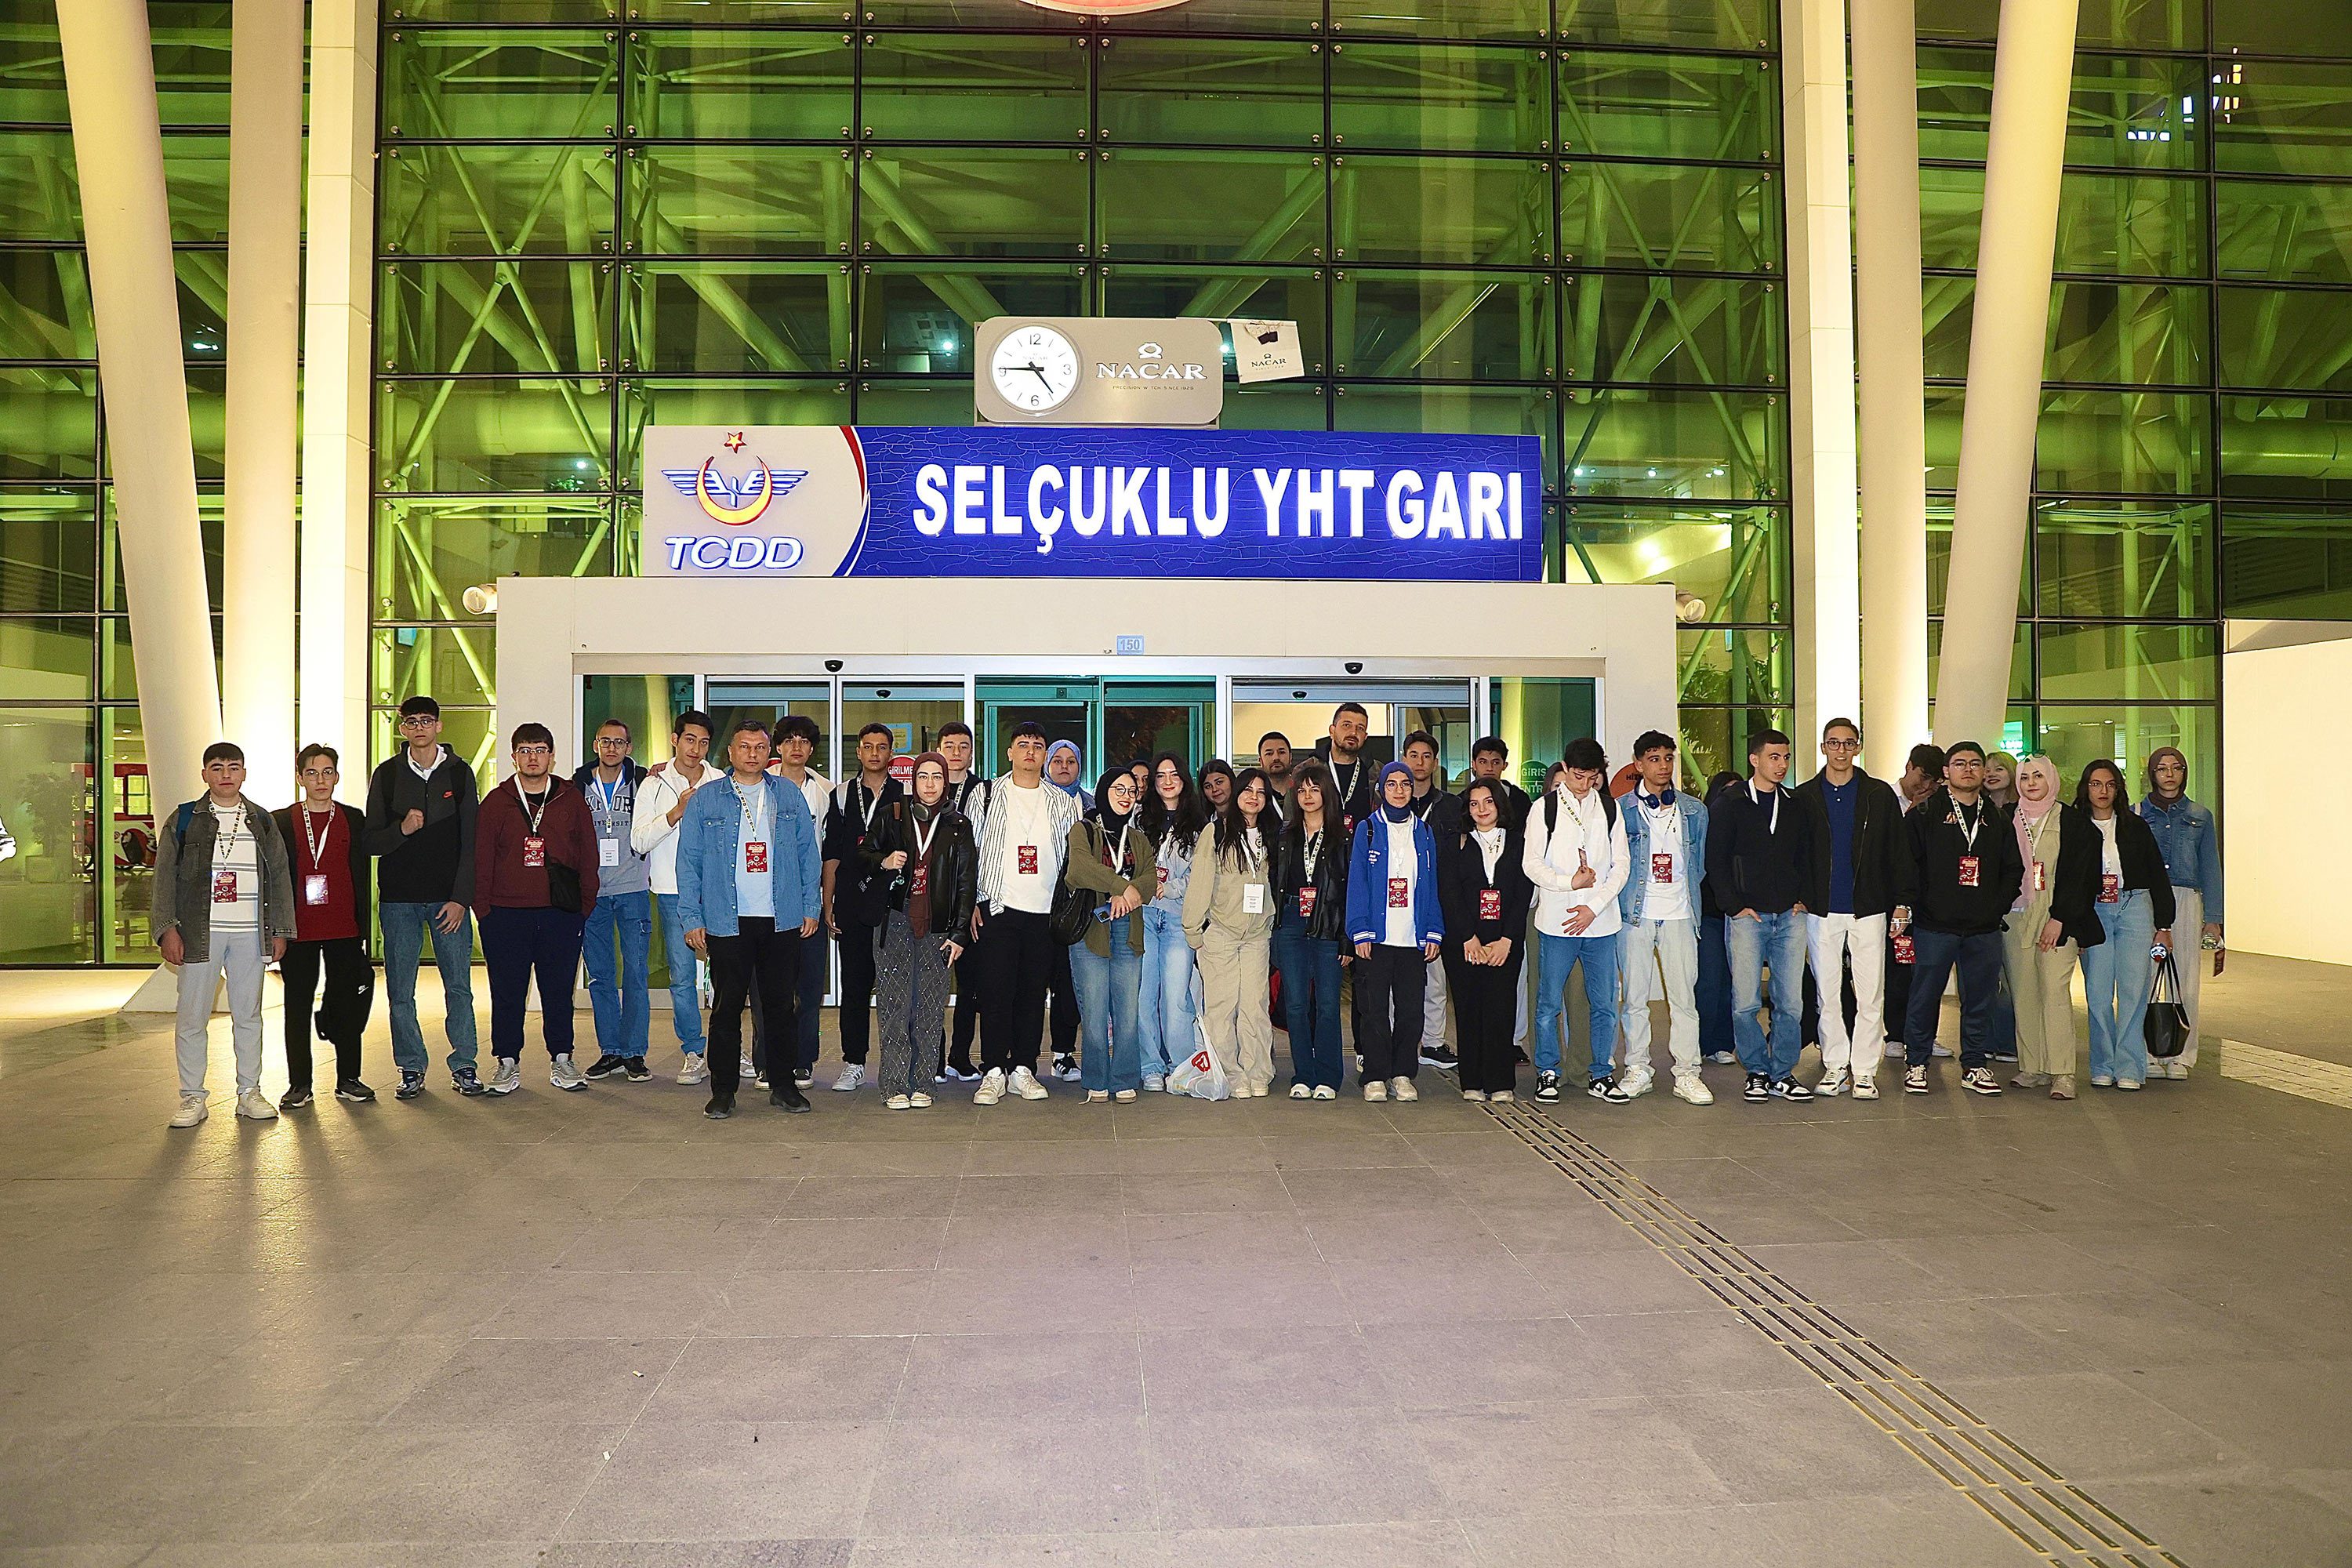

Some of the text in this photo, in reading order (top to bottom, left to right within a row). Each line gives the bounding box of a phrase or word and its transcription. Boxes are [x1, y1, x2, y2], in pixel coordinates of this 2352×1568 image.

[1029, 333, 1041, 345] 12
[1251, 358, 1286, 367] NACAR
[1063, 364, 1072, 375] 3
[1096, 362, 1208, 379] NACAR
[1031, 395, 1040, 406] 6
[912, 463, 1523, 554] SELÇUKLU YHT GARI
[665, 535, 804, 570] TCDD
[1120, 639, 1140, 650] 150
[887, 766, 913, 775] GİRİLME
[1521, 785, 1544, 793] NTR
